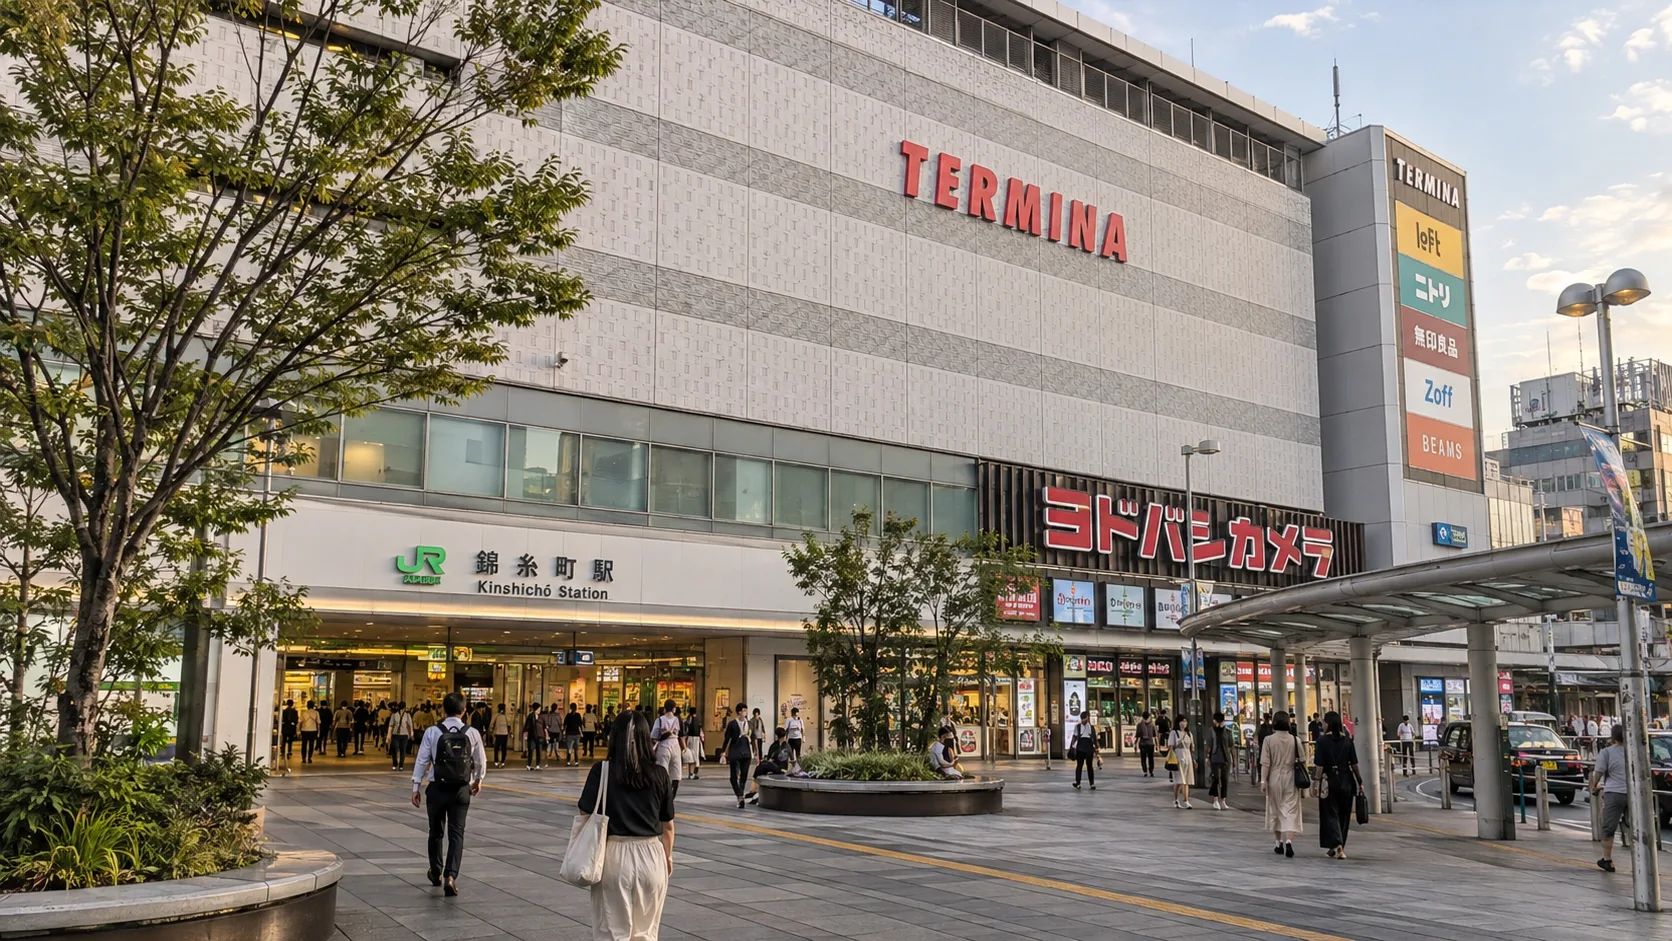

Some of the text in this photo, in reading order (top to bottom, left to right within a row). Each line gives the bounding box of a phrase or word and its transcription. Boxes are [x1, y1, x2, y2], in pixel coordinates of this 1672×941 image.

[1396, 157, 1460, 209] TERMINA
[901, 140, 1128, 263] TERMINA
[1415, 273, 1451, 309] ニトリ
[1414, 324, 1459, 360] 無印良品
[1424, 378, 1453, 409] Zoff
[1422, 433, 1463, 461] BEAMS
[1044, 486, 1334, 579] ヨドバシカメラ
[396, 545, 446, 575] JR
[475, 549, 614, 584] 錦糸町駅
[558, 585, 608, 601] Station
